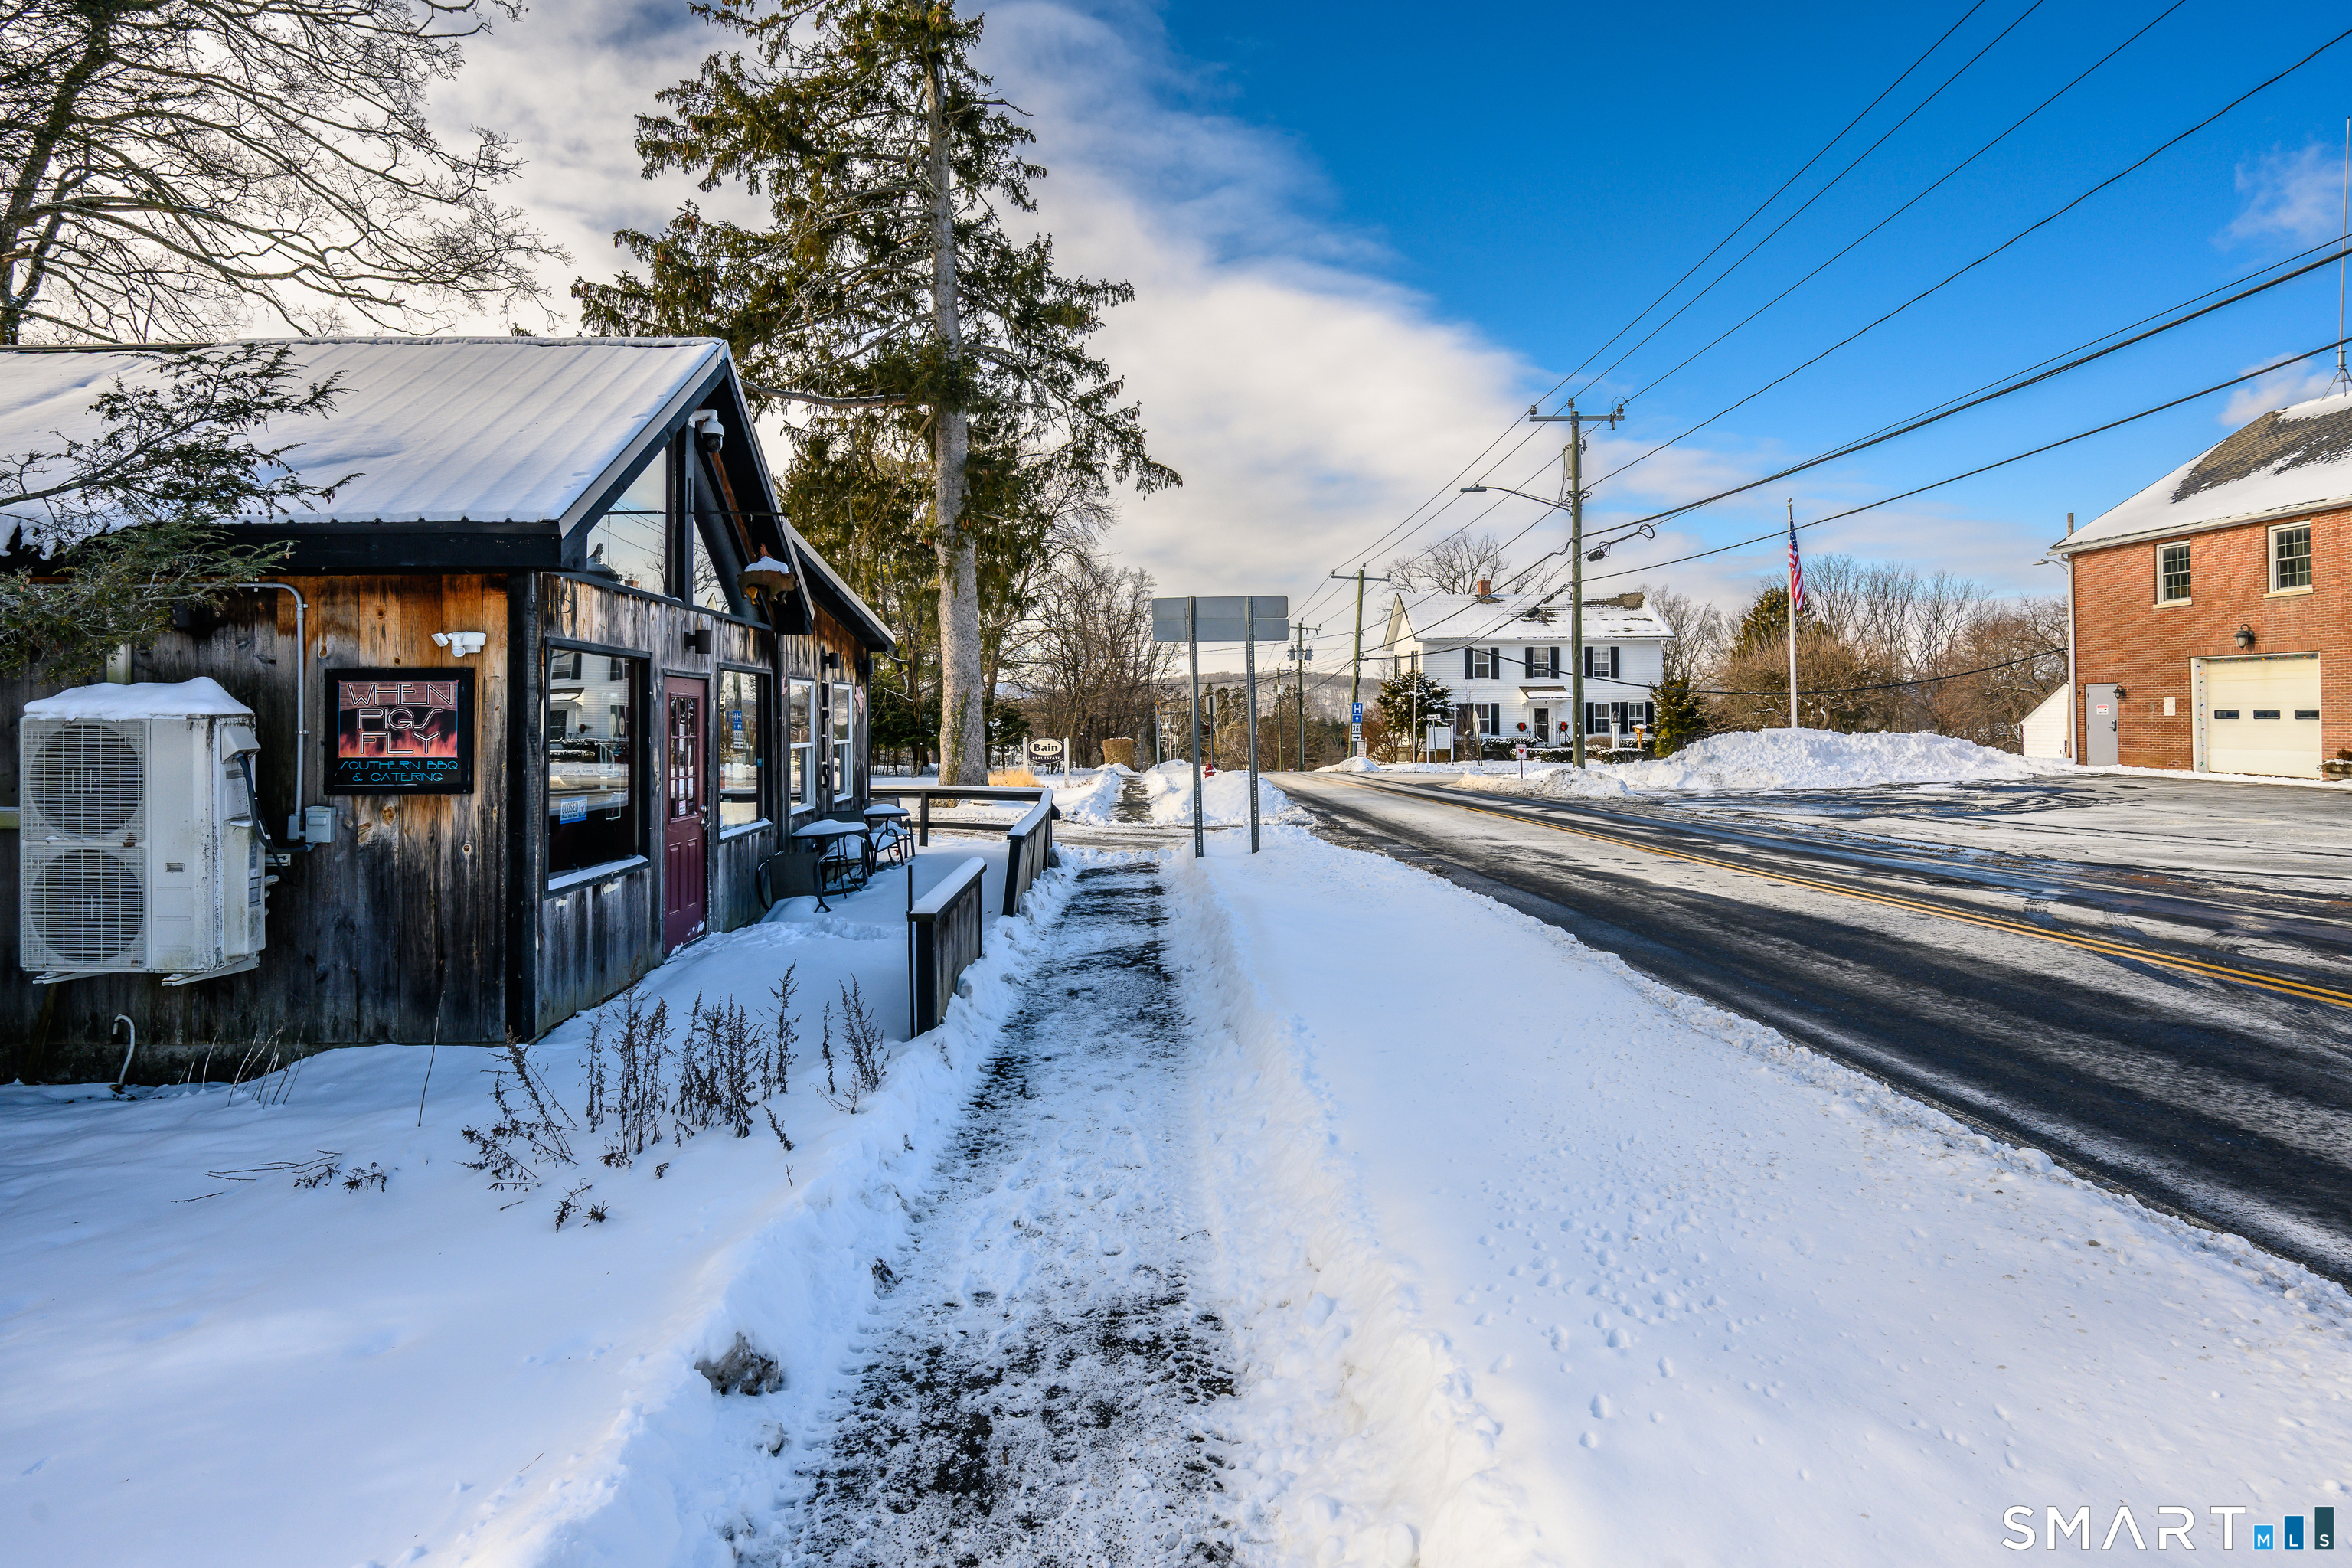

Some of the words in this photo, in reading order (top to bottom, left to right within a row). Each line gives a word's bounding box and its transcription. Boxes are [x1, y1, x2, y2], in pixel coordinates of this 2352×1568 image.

[348, 683, 453, 706] WHEN
[1354, 704, 1361, 714] H
[357, 707, 443, 730] PIGS
[361, 732, 439, 754] FLY
[338, 760, 420, 770] SOUTHERN
[426, 760, 459, 770] BBQ
[352, 773, 363, 782] &
[371, 772, 443, 782] CATERING
[562, 802, 578, 814] CLOSED
